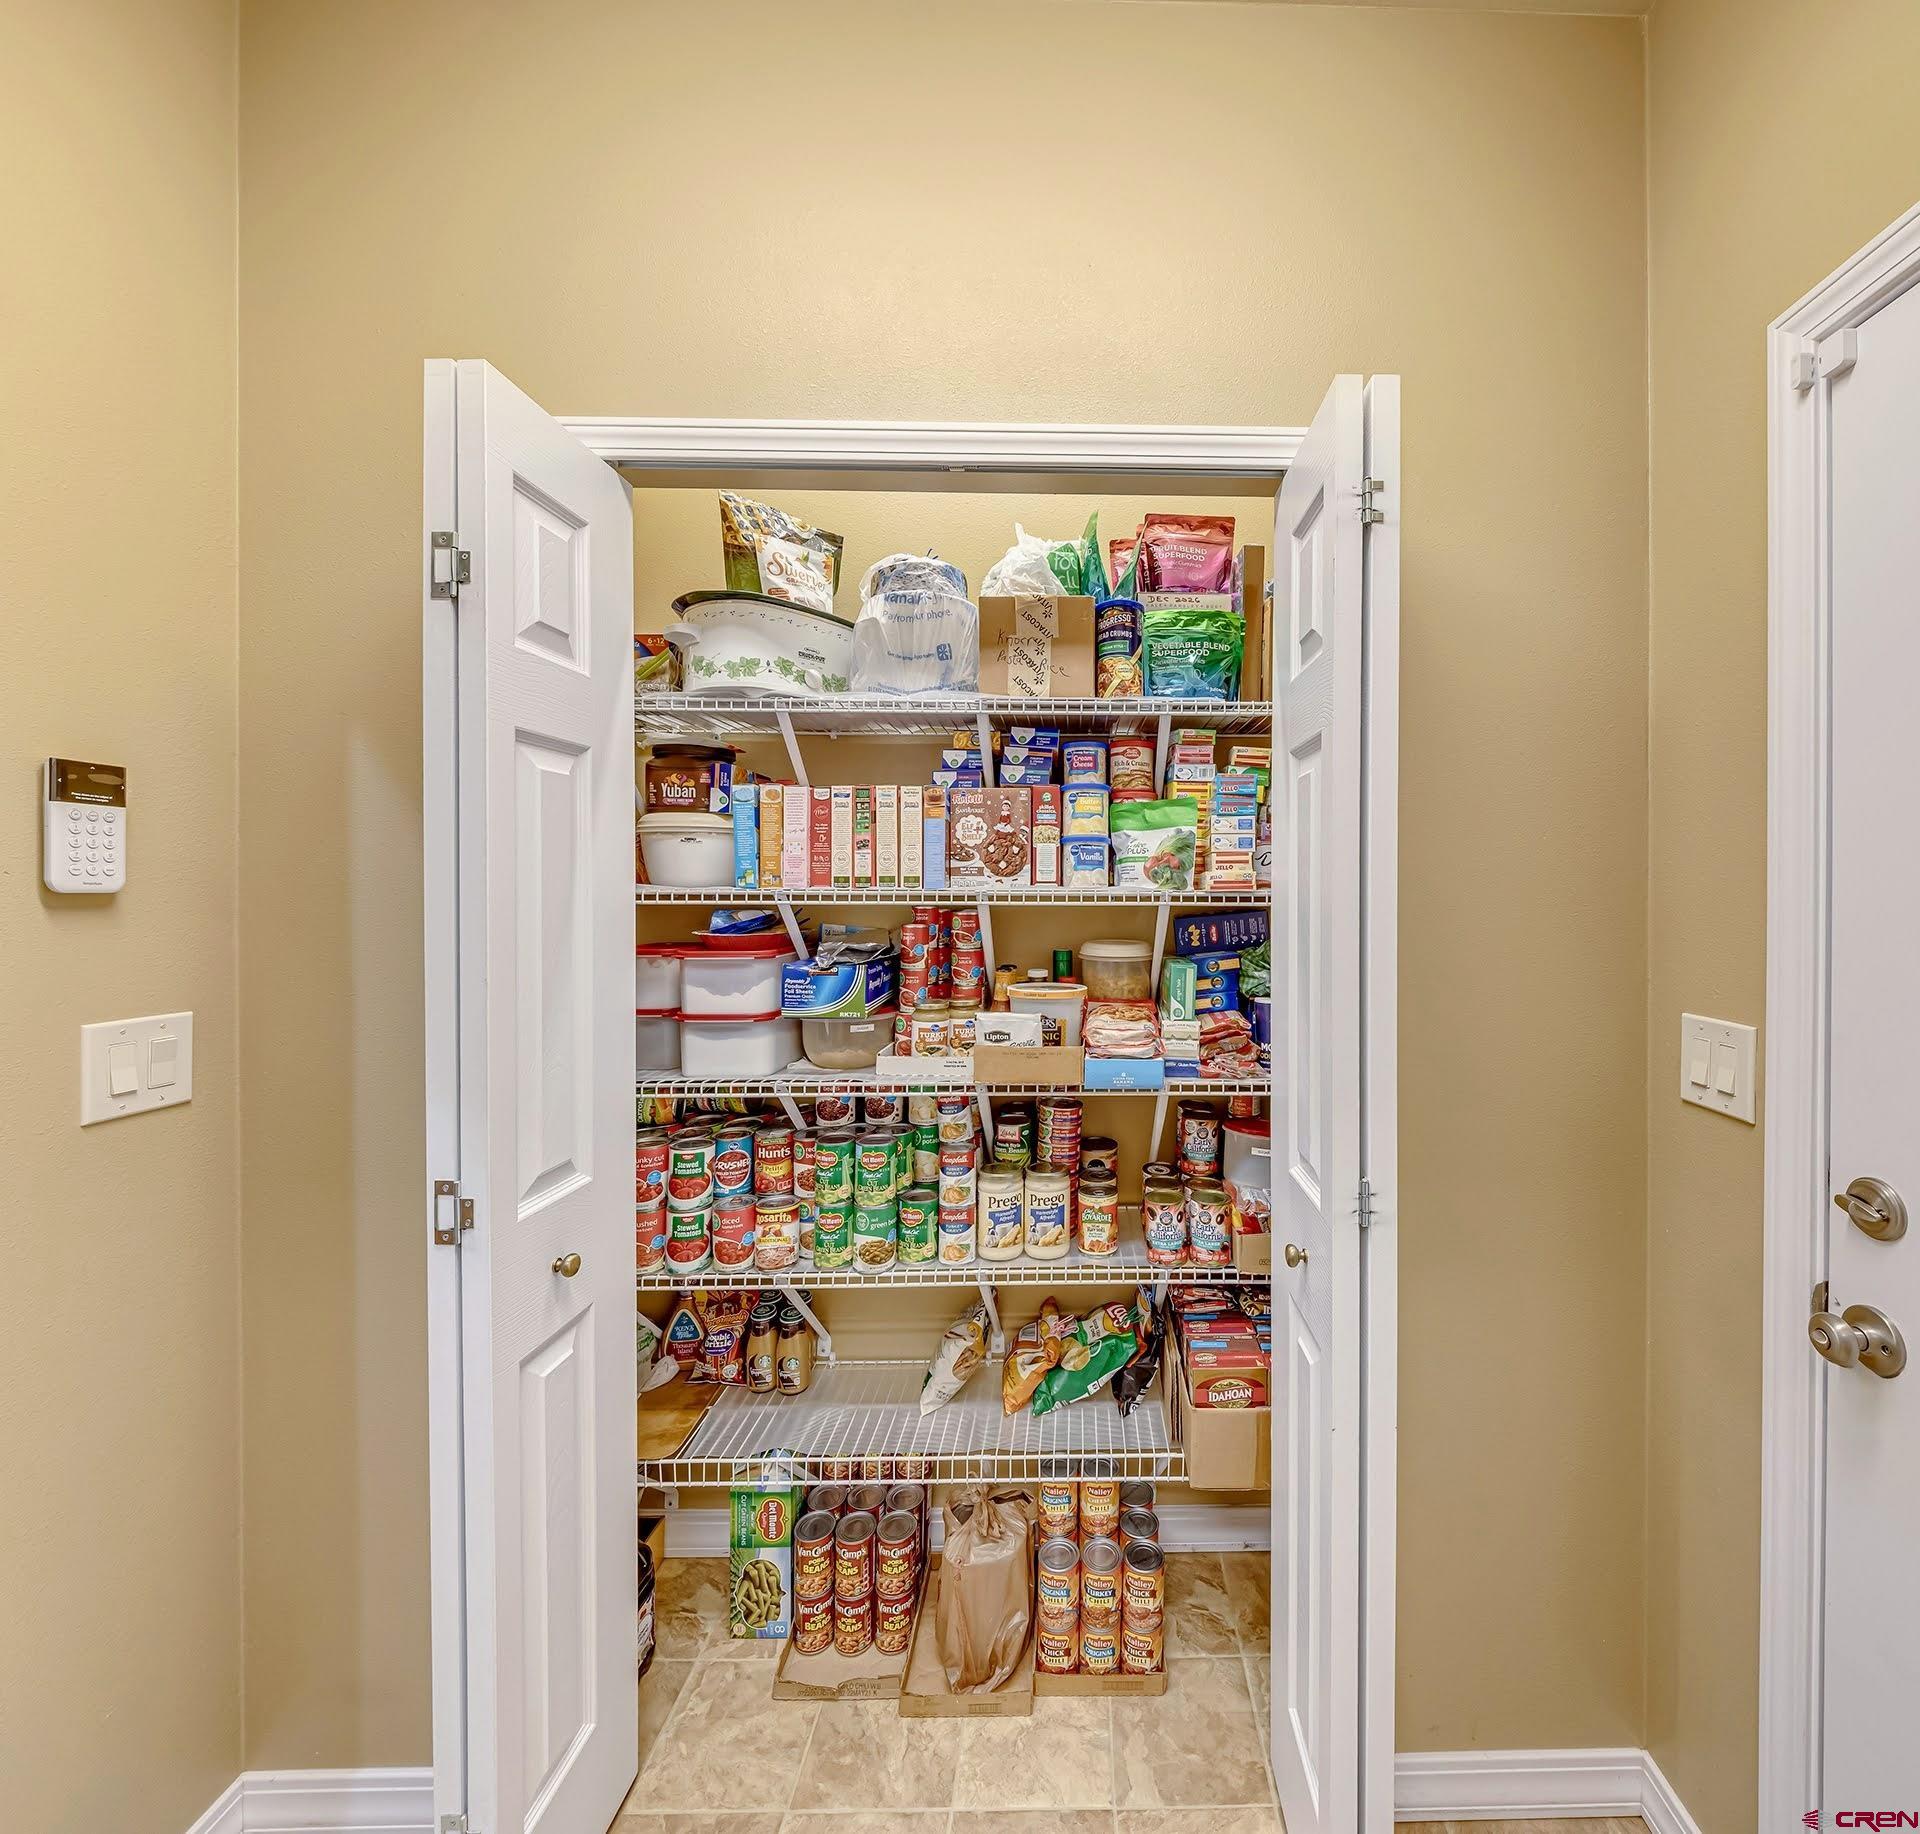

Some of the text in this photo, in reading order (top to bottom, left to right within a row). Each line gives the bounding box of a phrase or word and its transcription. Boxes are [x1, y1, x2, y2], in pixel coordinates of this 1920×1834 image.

[1181, 546, 1208, 556] BLEND
[1153, 552, 1205, 562] SUPERFOOD
[1021, 610, 1054, 638] VITACOST
[1151, 641, 1231, 652] VEGETABLE BLEND
[1151, 649, 1210, 658] SUPERFOOD
[1013, 646, 1045, 680] VITACOST
[661, 782, 697, 798] Yuban
[1080, 852, 1103, 862] Vanilla
[986, 1033, 1010, 1042] Lipton
[1193, 1138, 1213, 1147] Early
[758, 1147, 792, 1159] Hunt's
[674, 1168, 703, 1176] Tomatoes
[988, 1192, 1022, 1209] Prego
[1030, 1193, 1065, 1208] Prego
[721, 1216, 740, 1224] diced
[870, 1221, 887, 1230] green
[1156, 1222, 1178, 1233] Early
[1195, 1222, 1216, 1232] Early
[674, 1231, 702, 1239] Tomatoes
[1150, 1230, 1183, 1240] California
[674, 1324, 695, 1332] KEN'S
[704, 1339, 732, 1348] Drizzle
[1208, 1387, 1253, 1403] IDAHOAN
[1043, 1486, 1068, 1496] Nalley
[1087, 1486, 1113, 1496] Nalley
[1042, 1496, 1070, 1504] ORIGINAL
[1045, 1504, 1067, 1512] CHILI
[1089, 1504, 1111, 1512] CHILI
[767, 1501, 777, 1539] Del Monte
[797, 1537, 834, 1557] VanCamp
[836, 1546, 867, 1560] nCamp's
[802, 1558, 830, 1574] BEANS
[882, 1561, 909, 1575] BEANS
[1041, 1575, 1066, 1589] Nalley
[1087, 1577, 1113, 1589] Nalley
[1127, 1576, 1154, 1589] Nalley
[1086, 1588, 1114, 1597] TURKEY
[1129, 1588, 1152, 1598] THICK
[798, 1593, 835, 1615] VanCamp
[1129, 1597, 1151, 1605] CHILI
[835, 1602, 871, 1617] anCamp's
[804, 1614, 832, 1632] BEANS
[837, 1622, 863, 1633] BEANS
[883, 1615, 910, 1631] BEANS
[774, 1625, 785, 1633] 8
[1042, 1636, 1067, 1648] Nalley
[1087, 1636, 1113, 1648] Nalley
[1125, 1633, 1150, 1649] Nalley
[1043, 1647, 1065, 1657] THICK
[1085, 1647, 1114, 1657] ORIGINAL
[1126, 1644, 1148, 1657] THICK
